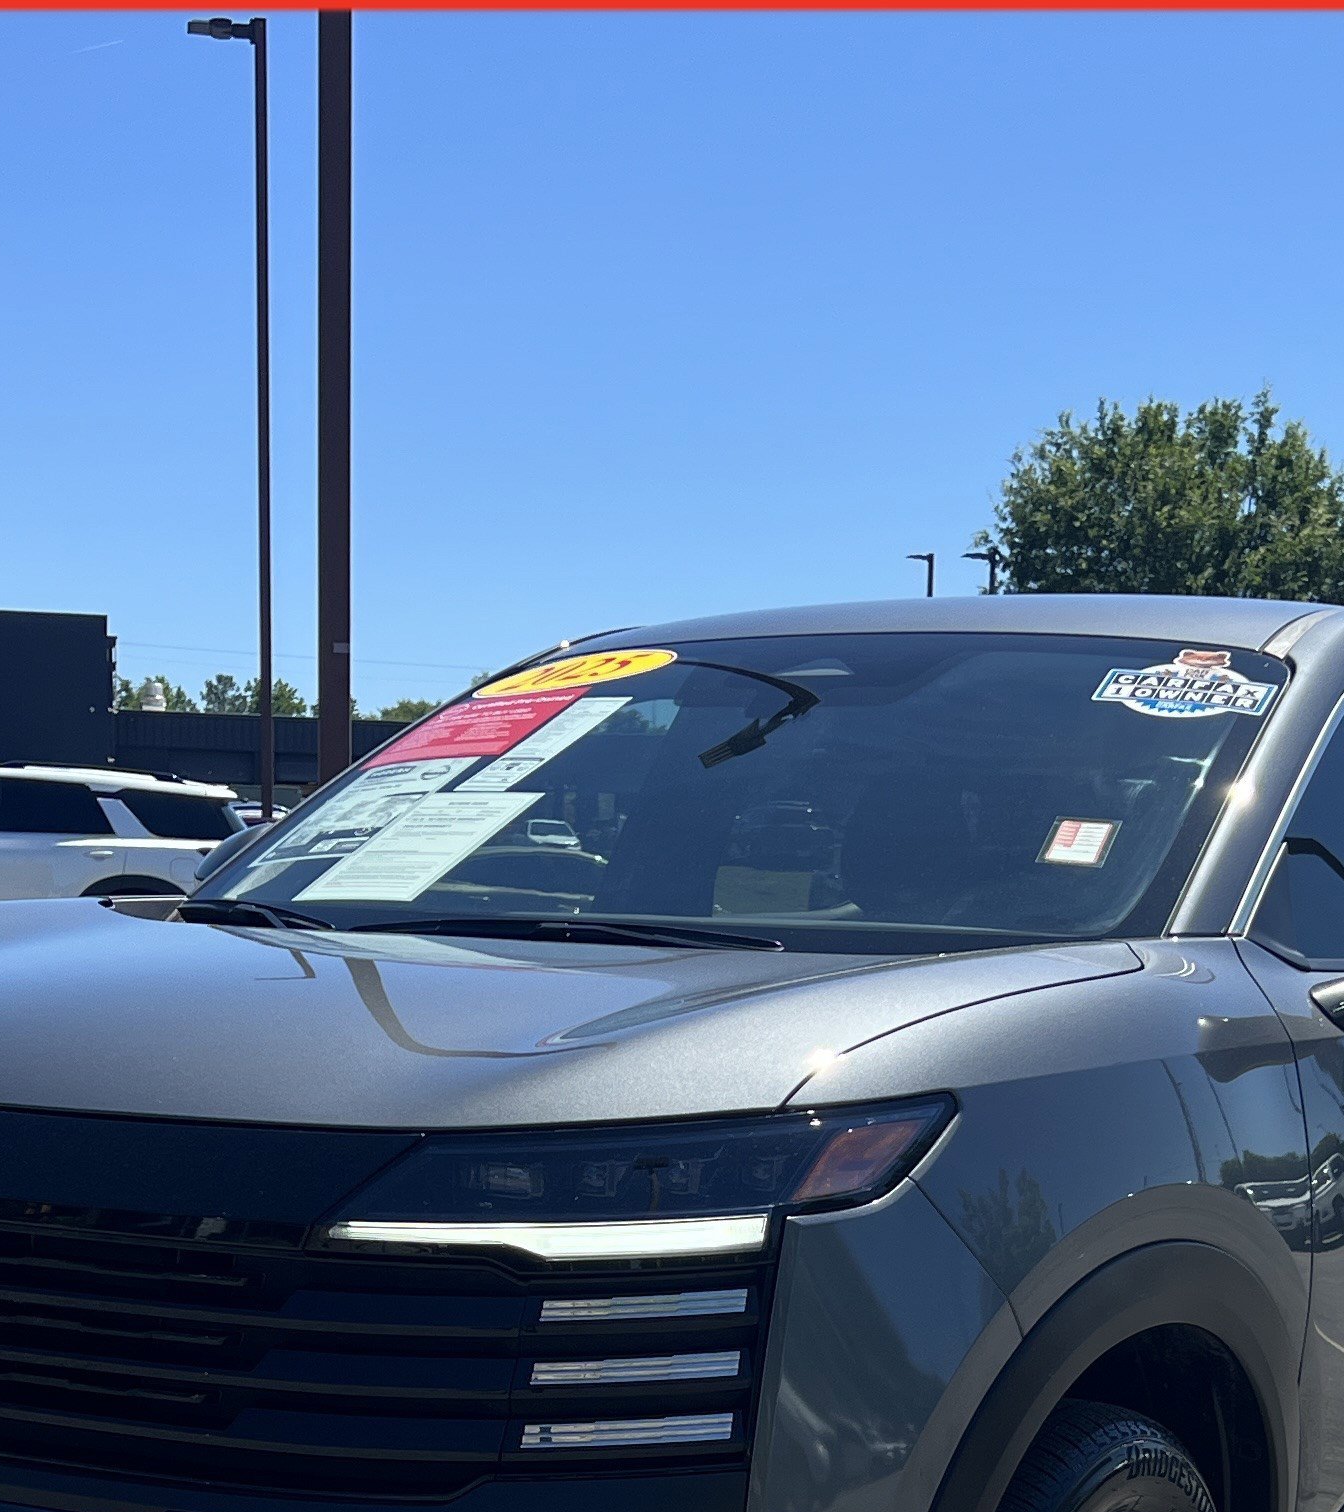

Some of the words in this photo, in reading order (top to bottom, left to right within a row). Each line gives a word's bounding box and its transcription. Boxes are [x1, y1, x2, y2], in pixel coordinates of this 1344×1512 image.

[1117, 674, 1260, 697] CARFAX
[1113, 686, 1124, 695] 1
[1132, 688, 1257, 708] OWNER
